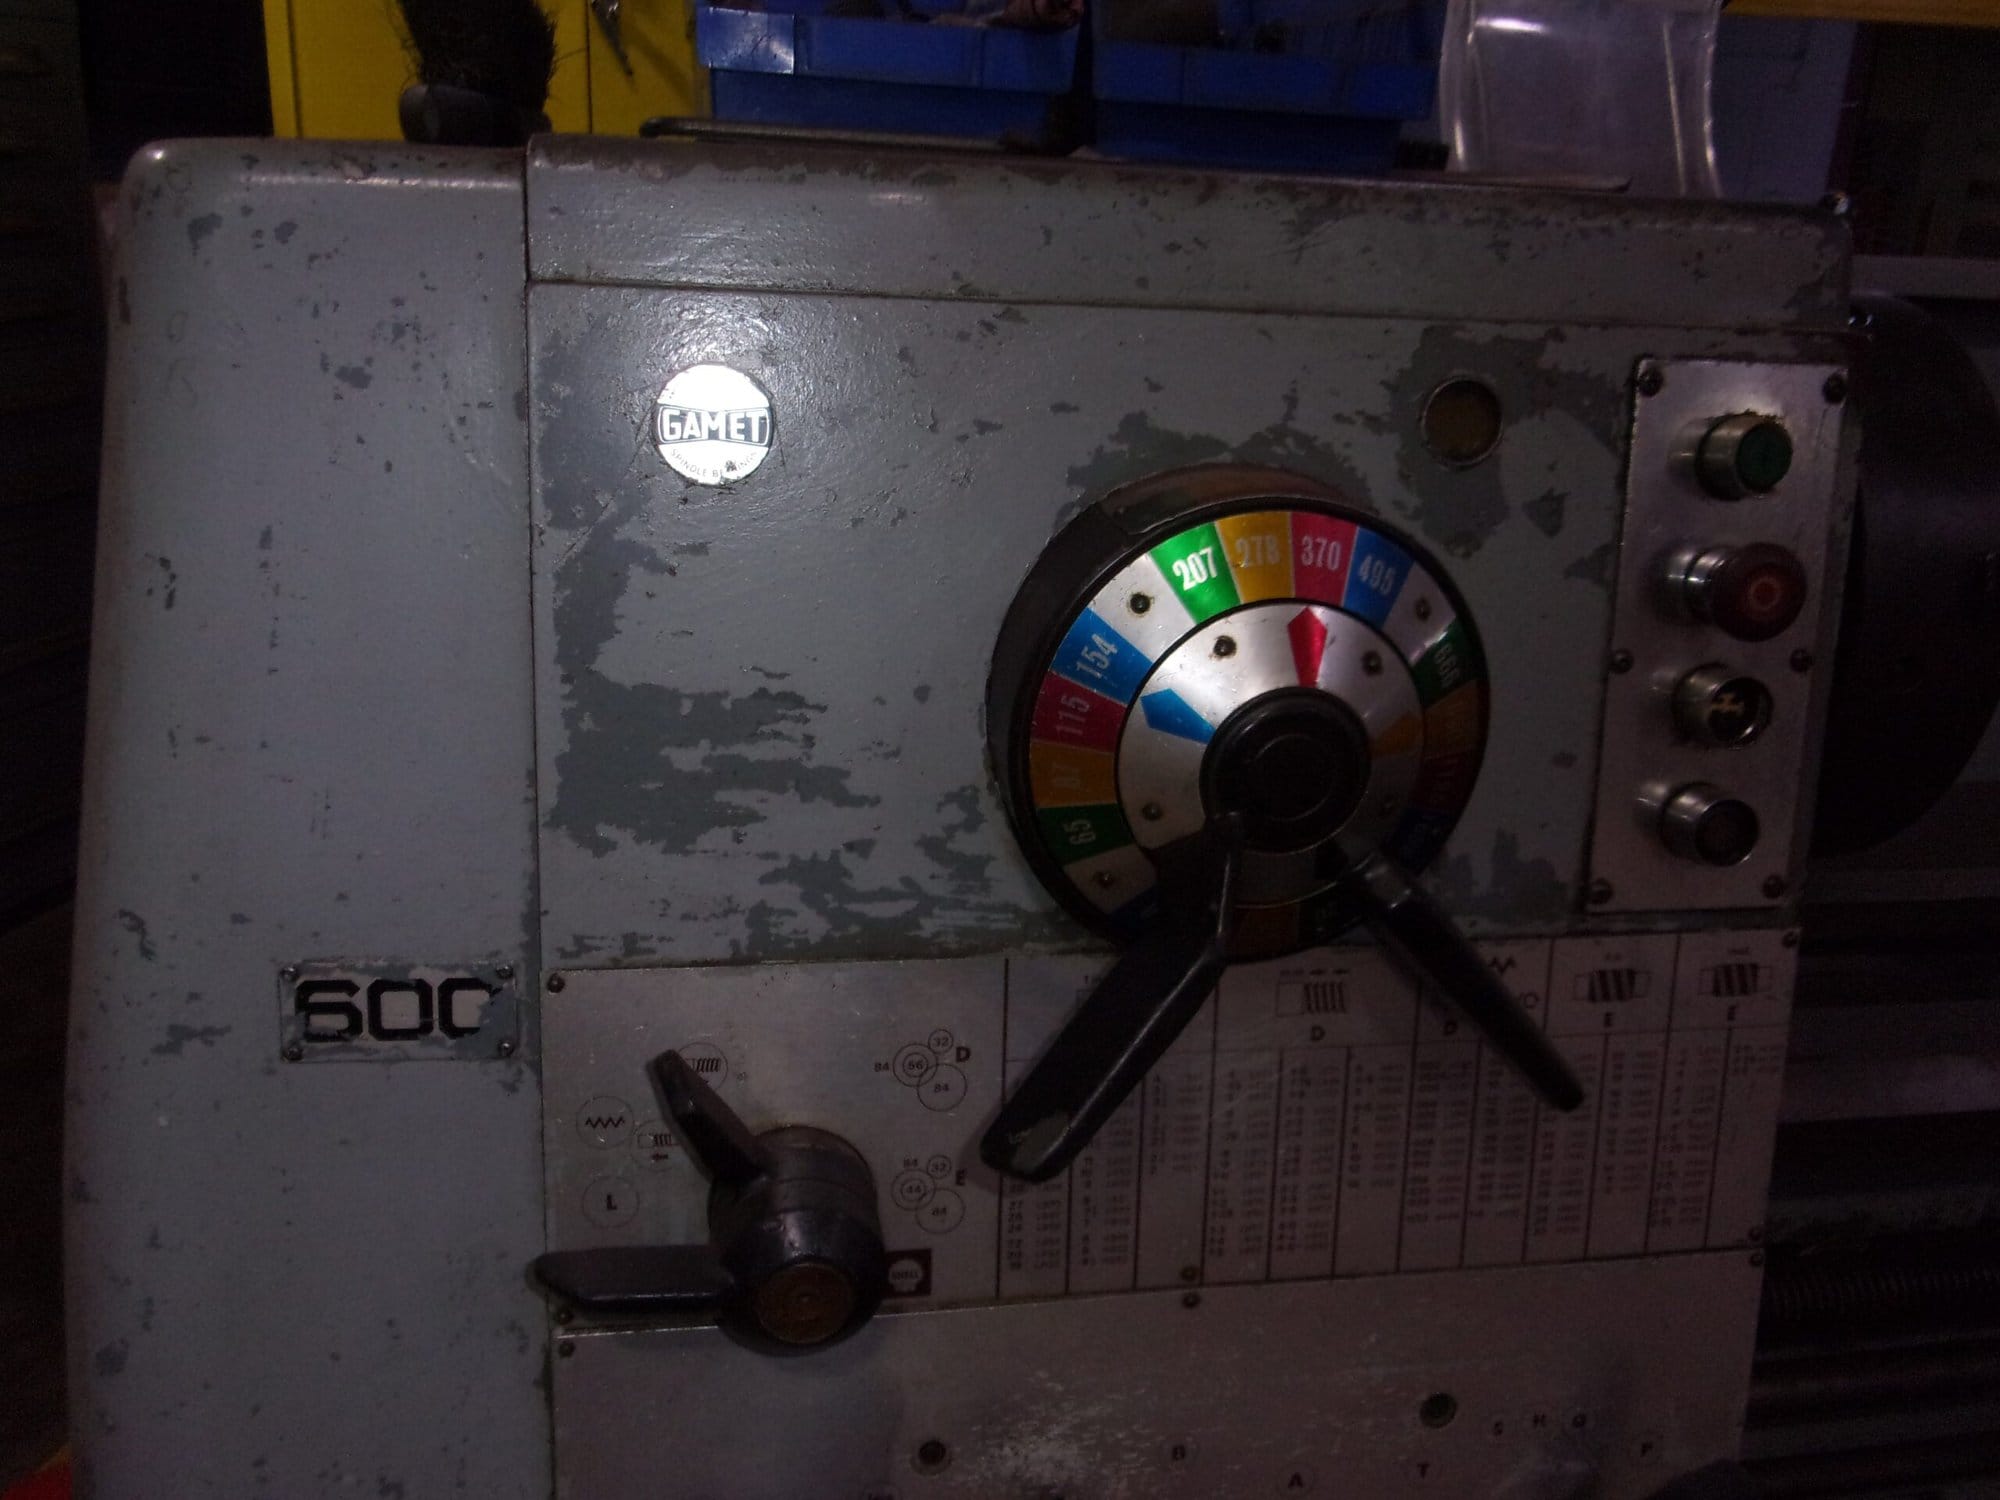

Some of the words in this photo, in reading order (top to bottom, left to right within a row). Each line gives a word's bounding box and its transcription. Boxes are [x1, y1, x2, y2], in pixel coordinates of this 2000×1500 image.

[662, 408, 766, 443] GAMET
[671, 448, 706, 477] SPINDLE
[1171, 546, 1218, 591] 207
[1235, 534, 1281, 569] 278
[1300, 535, 1341, 571] 370
[1358, 554, 1396, 596] 495
[1075, 633, 1119, 679] 154
[1055, 695, 1091, 737] 115
[1310, 1024, 1326, 1041] D
[955, 1046, 971, 1062] D
[606, 1194, 617, 1211] L
[1287, 1471, 1303, 1489] A
[1417, 1462, 1430, 1479] T
